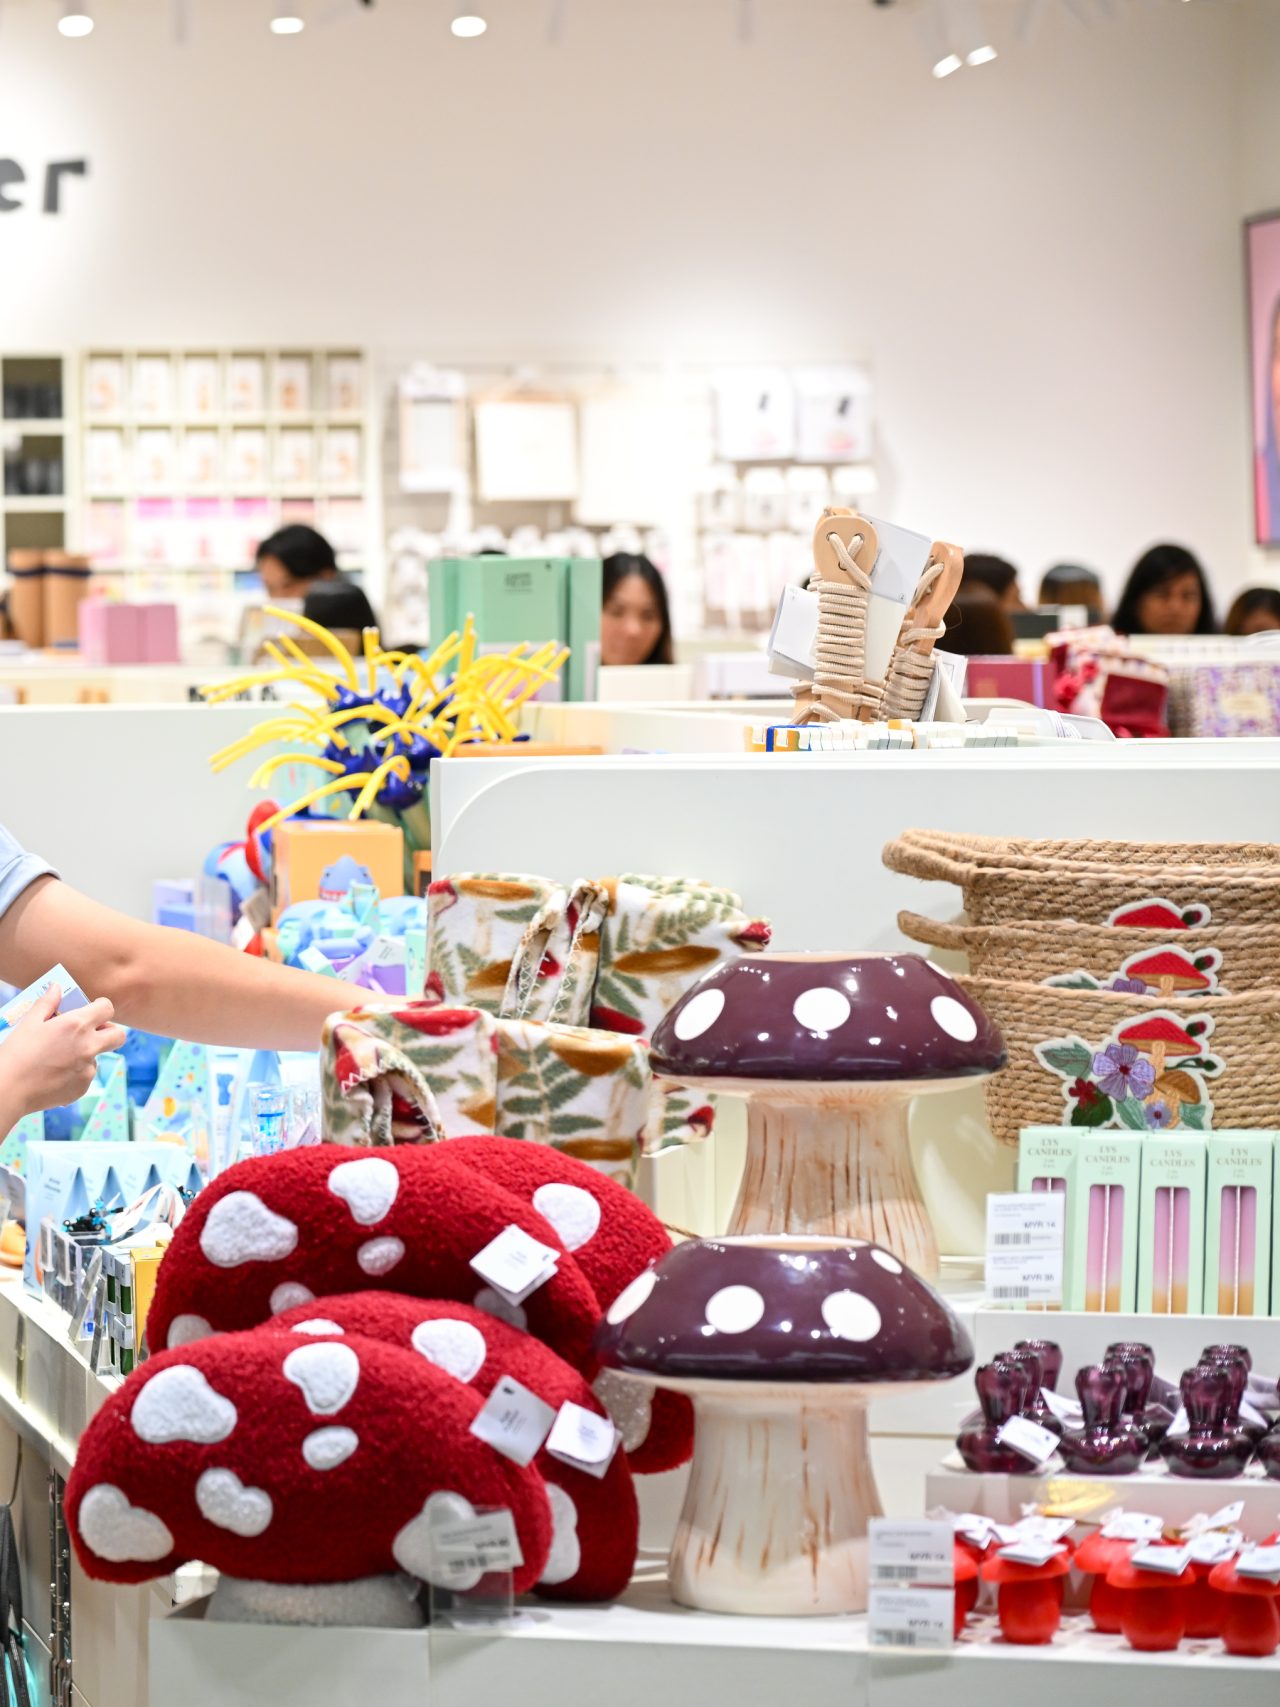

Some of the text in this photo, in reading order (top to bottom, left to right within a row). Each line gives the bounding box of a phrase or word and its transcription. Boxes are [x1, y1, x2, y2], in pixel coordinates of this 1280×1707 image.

[1027, 1148, 1073, 1156] CANDLES
[1085, 1155, 1131, 1163] CANDLES
[1150, 1159, 1196, 1167] CANDLES
[1216, 1157, 1262, 1166] CANDLES
